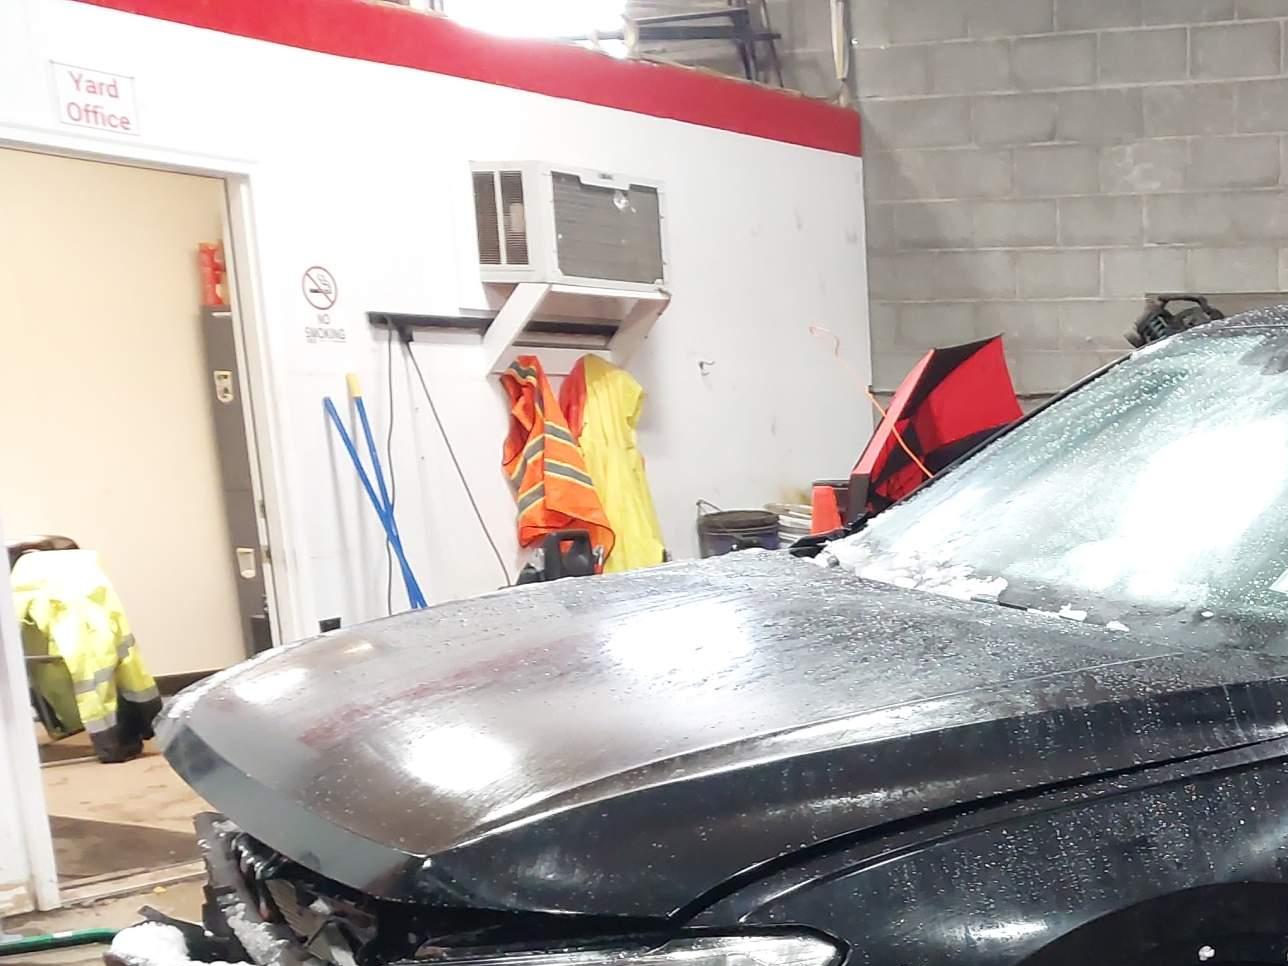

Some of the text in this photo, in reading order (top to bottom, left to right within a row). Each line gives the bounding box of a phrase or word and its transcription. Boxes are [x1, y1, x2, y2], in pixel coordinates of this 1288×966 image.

[68, 71, 119, 98] Yard
[66, 102, 131, 131] Office
[304, 326, 346, 339] SMOKING
